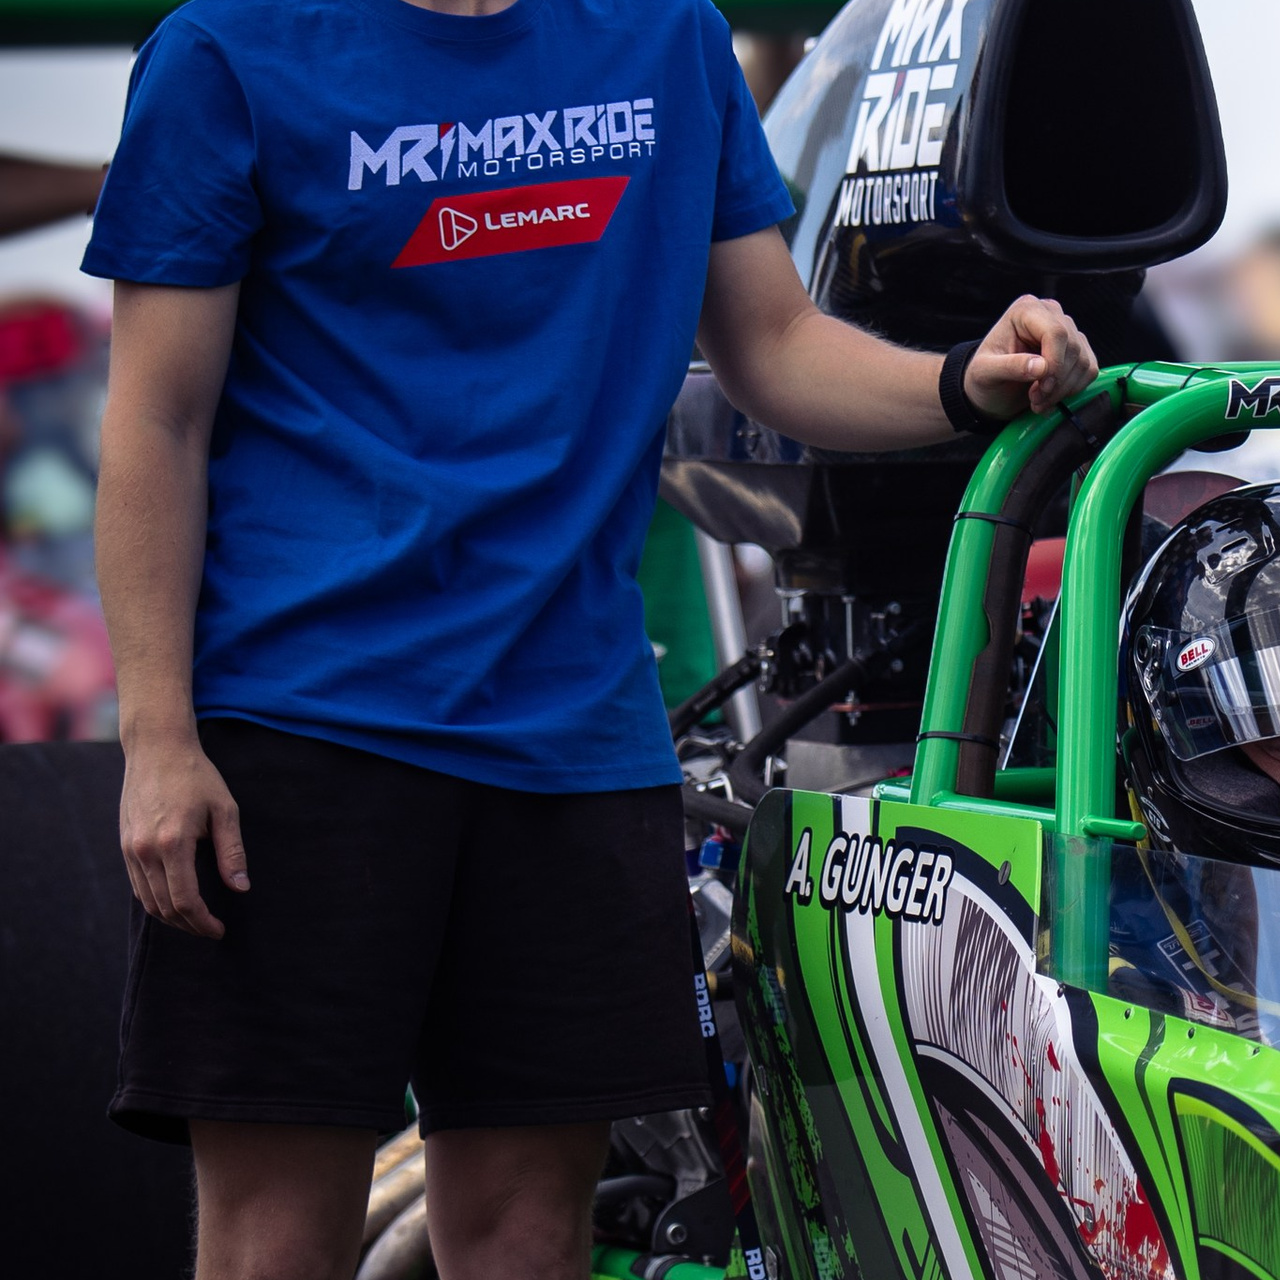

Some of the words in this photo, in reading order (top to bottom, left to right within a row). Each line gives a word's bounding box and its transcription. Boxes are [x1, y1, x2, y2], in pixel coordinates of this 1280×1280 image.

[846, 63, 959, 175] RIDE
[457, 140, 656, 179] MOTORSPORT
[484, 202, 591, 231] LEMARC
[834, 171, 939, 228] MOTORSPORT
[1180, 642, 1210, 666] BELL
[784, 830, 812, 898] A.
[820, 835, 954, 921] GUNGER
